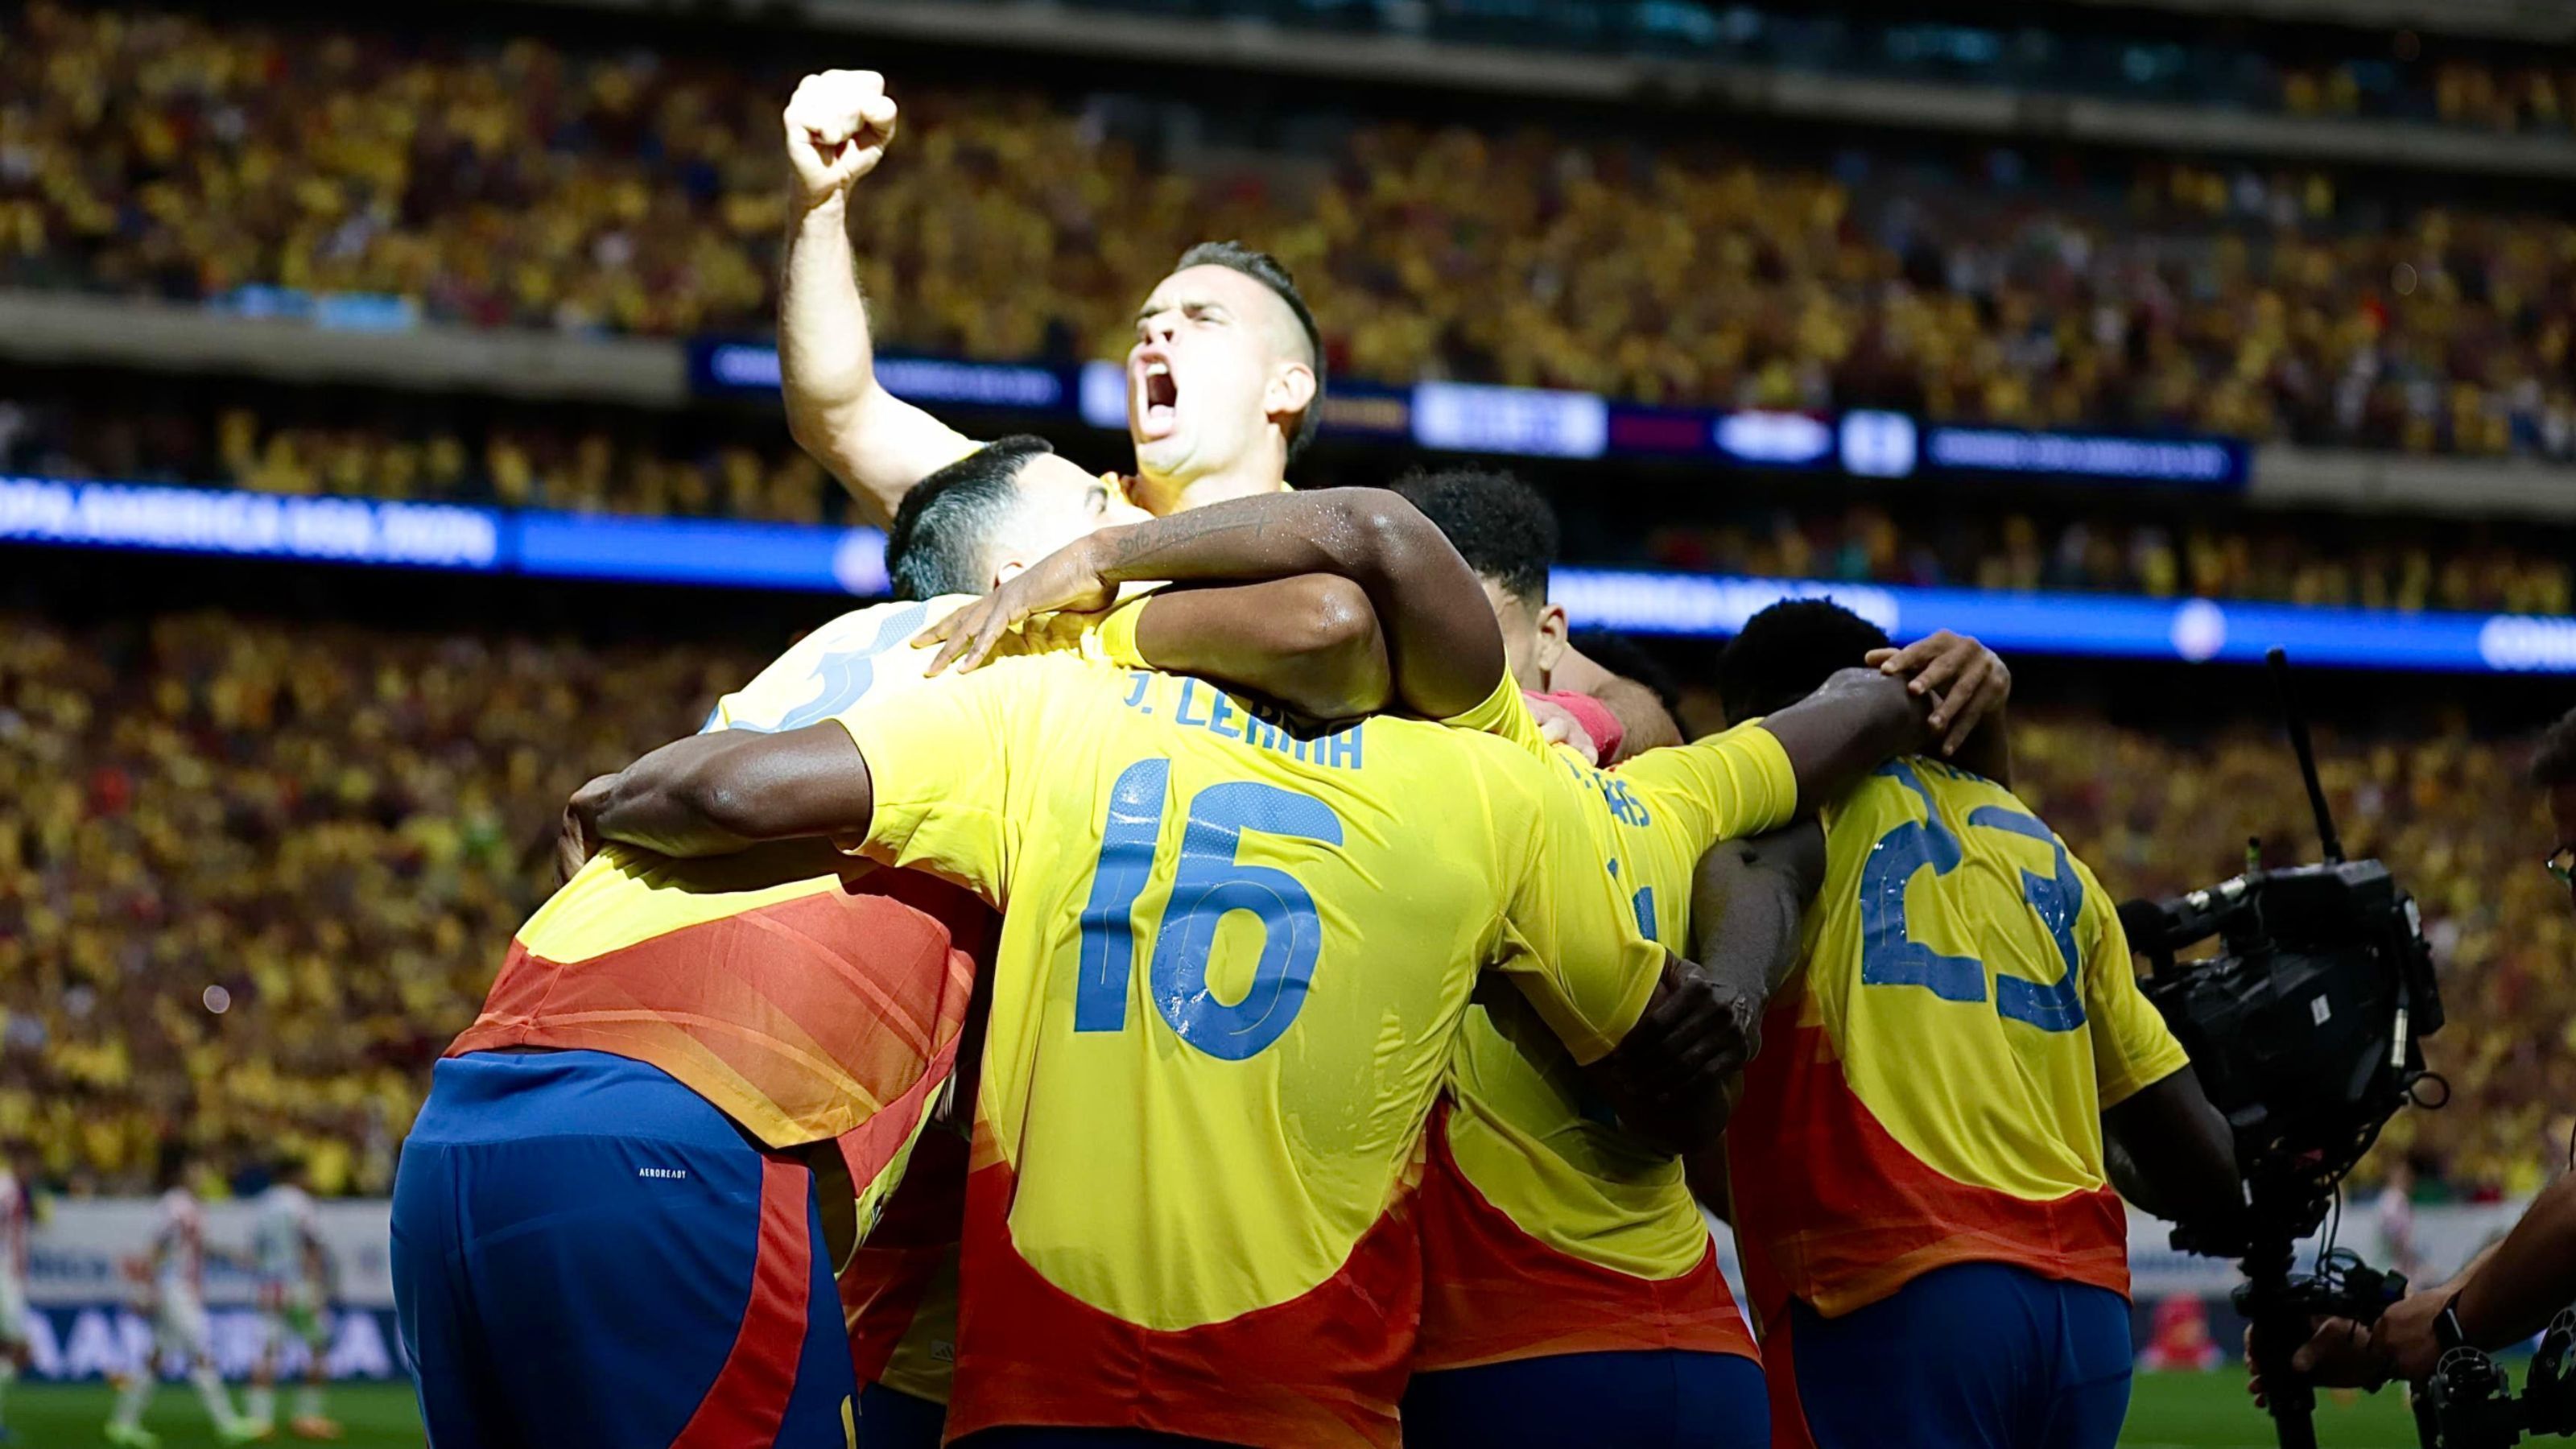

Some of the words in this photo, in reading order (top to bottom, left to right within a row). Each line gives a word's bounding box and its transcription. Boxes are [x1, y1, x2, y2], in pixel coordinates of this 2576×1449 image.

[1123, 673, 1153, 714] J.
[1073, 758, 1344, 1061] 16
[1860, 756, 2088, 1033] 23
[638, 1167, 686, 1179] AEROREADY
